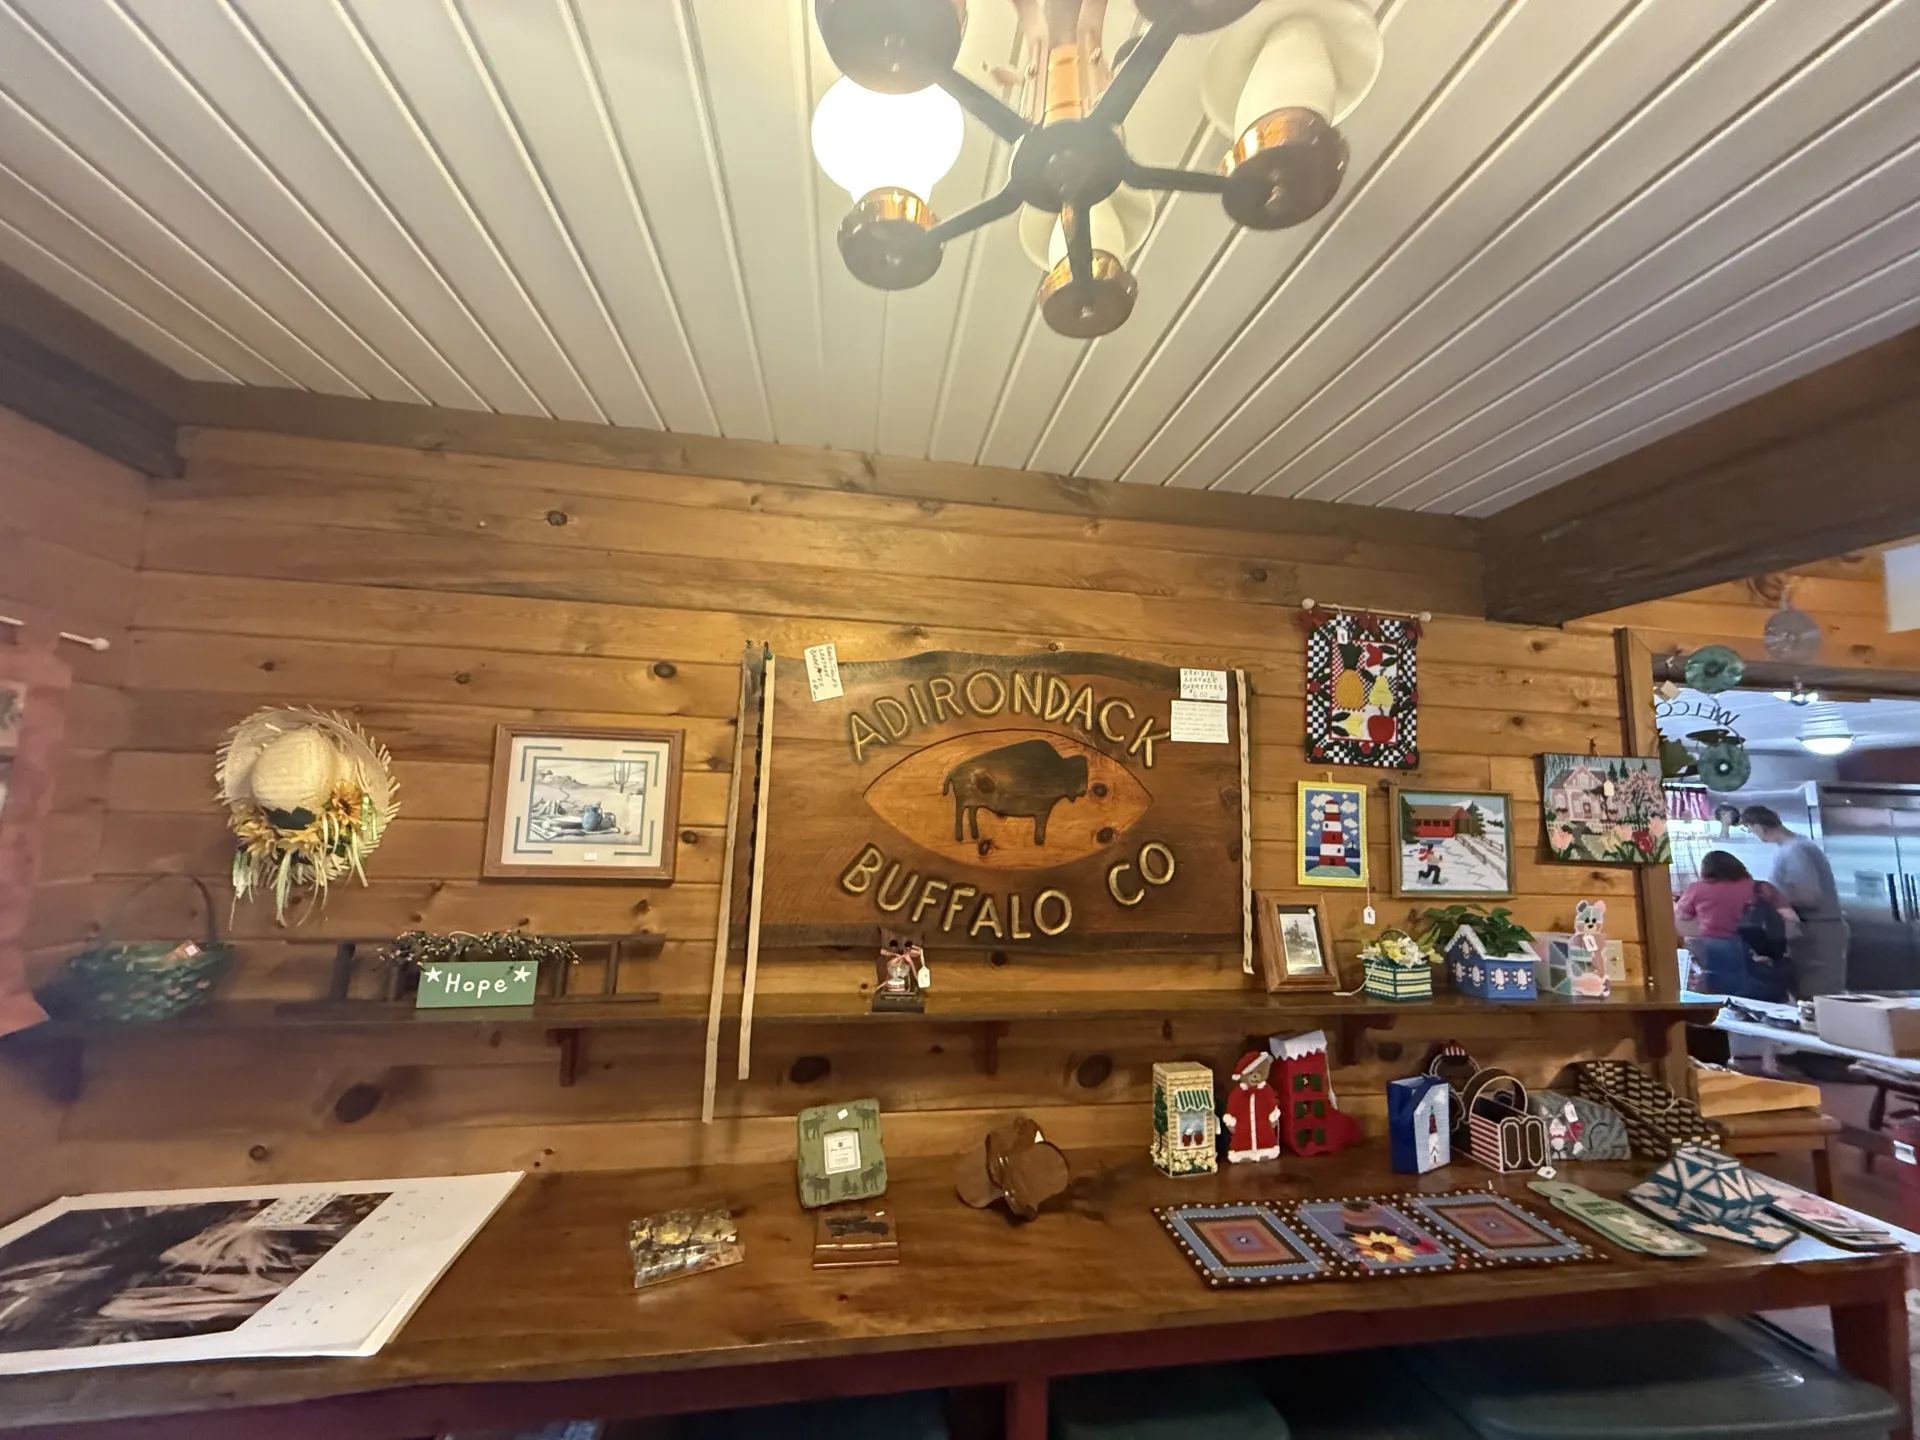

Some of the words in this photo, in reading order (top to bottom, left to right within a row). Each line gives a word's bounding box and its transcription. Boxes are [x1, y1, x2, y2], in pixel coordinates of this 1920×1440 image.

[1183, 670, 1215, 678] BRAIDED
[849, 670, 1170, 768] ADIRONDACK
[841, 843, 1072, 940] BUFFALO
[1108, 841, 1177, 906] CO
[445, 973, 508, 999] Hope
